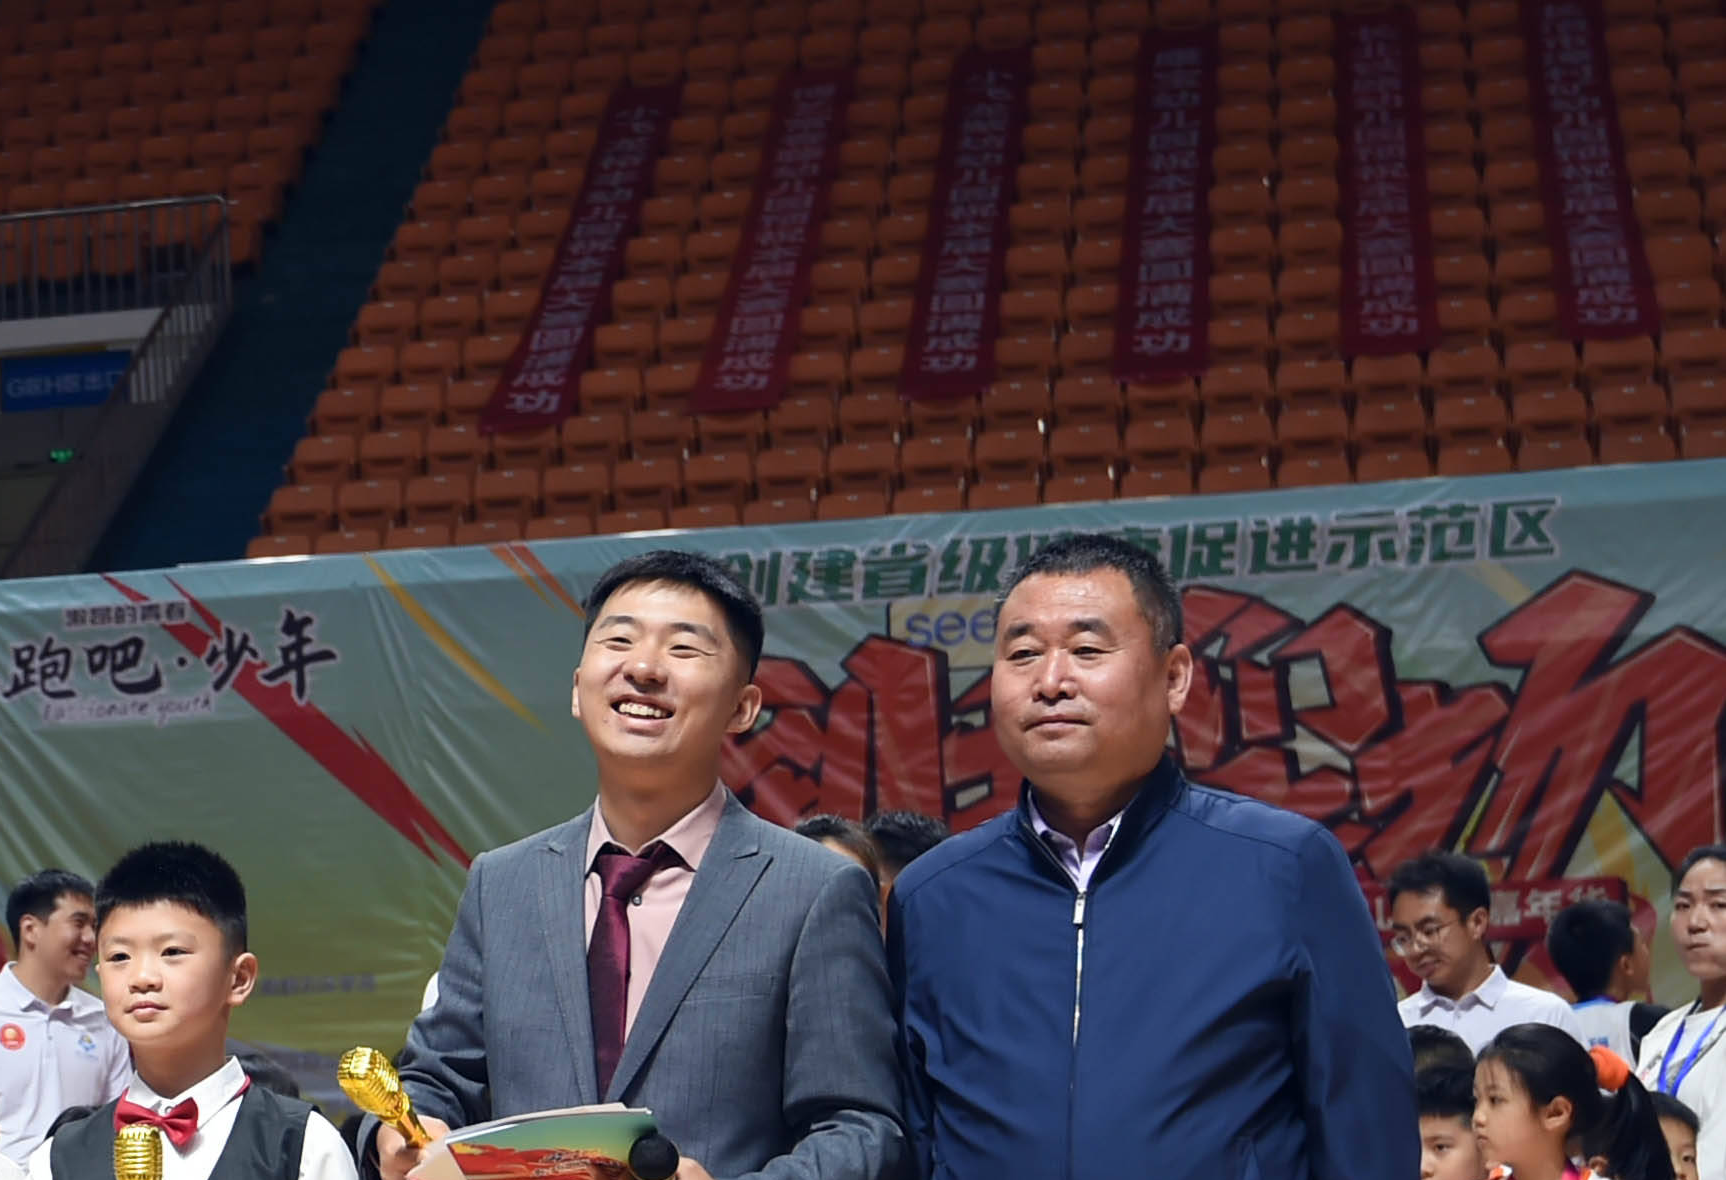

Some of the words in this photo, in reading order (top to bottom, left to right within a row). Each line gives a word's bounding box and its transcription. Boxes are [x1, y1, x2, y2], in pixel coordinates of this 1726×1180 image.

[726, 498, 1558, 605] 创建省级促进示范区
